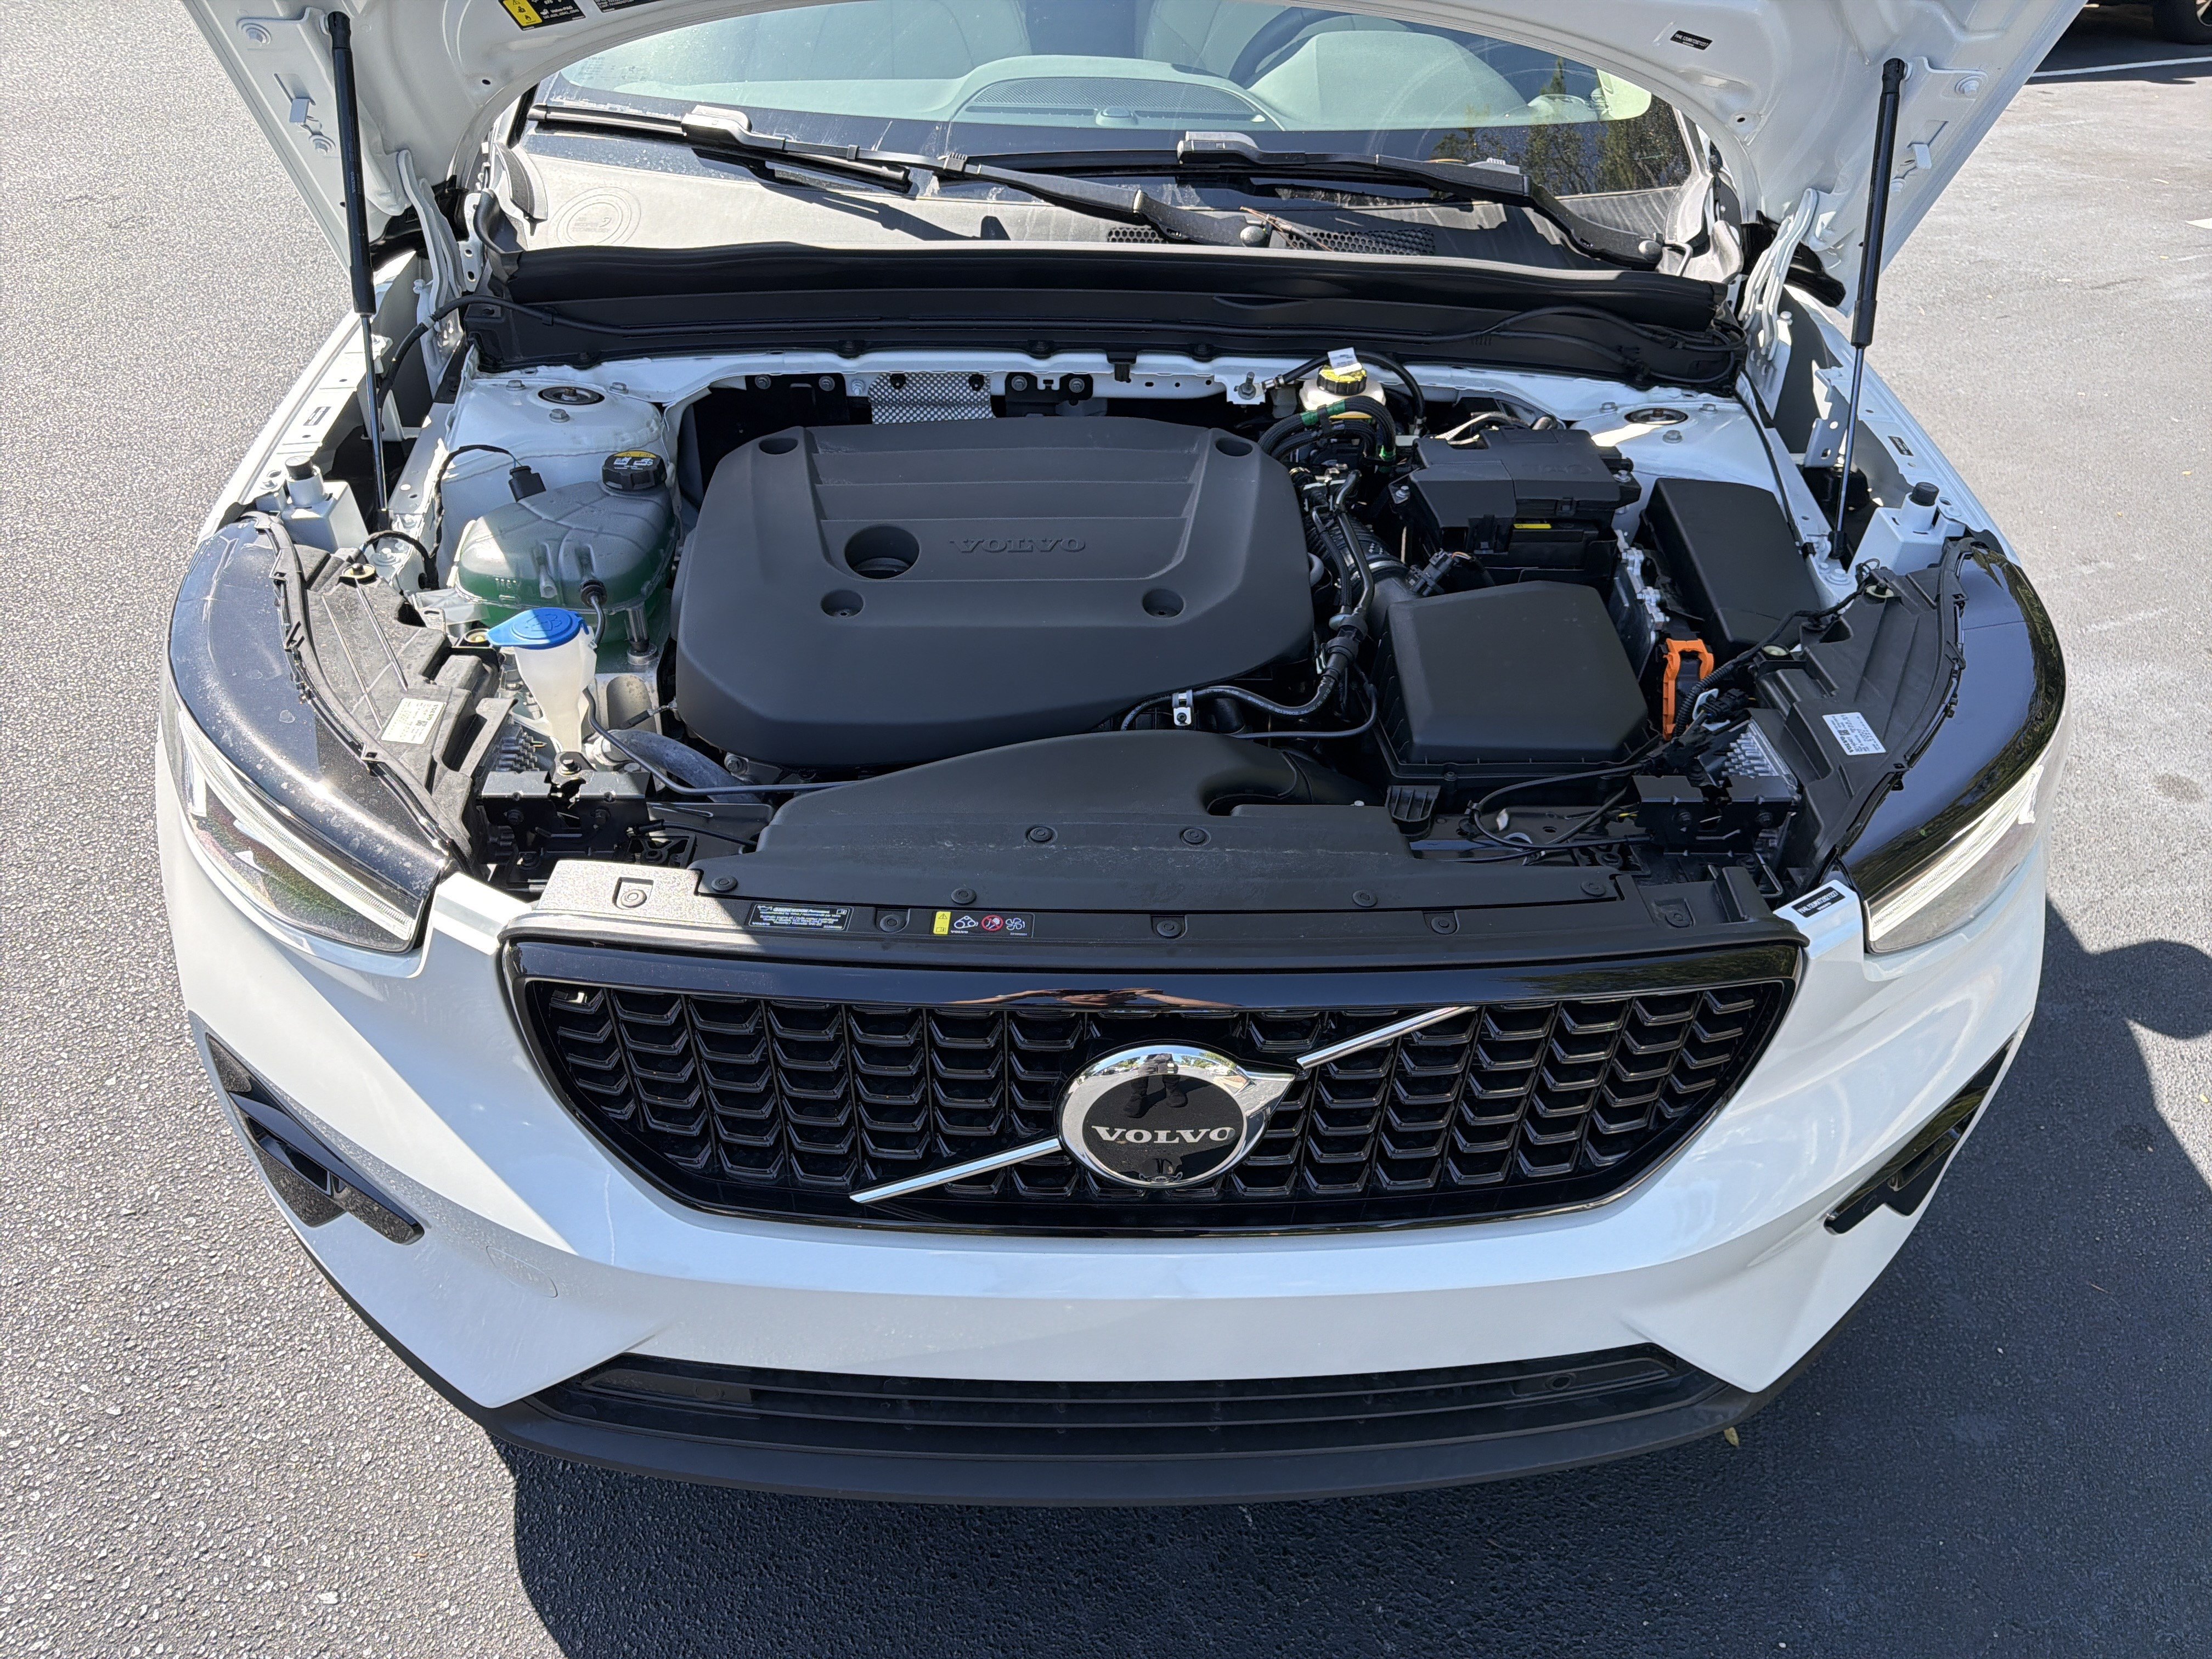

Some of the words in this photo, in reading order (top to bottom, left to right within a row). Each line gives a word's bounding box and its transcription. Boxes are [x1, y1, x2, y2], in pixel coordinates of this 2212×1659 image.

[949, 539, 1086, 554] VOLVO
[1839, 736, 1854, 753] VOLVO
[1091, 1125, 1234, 1143] VOLVO
